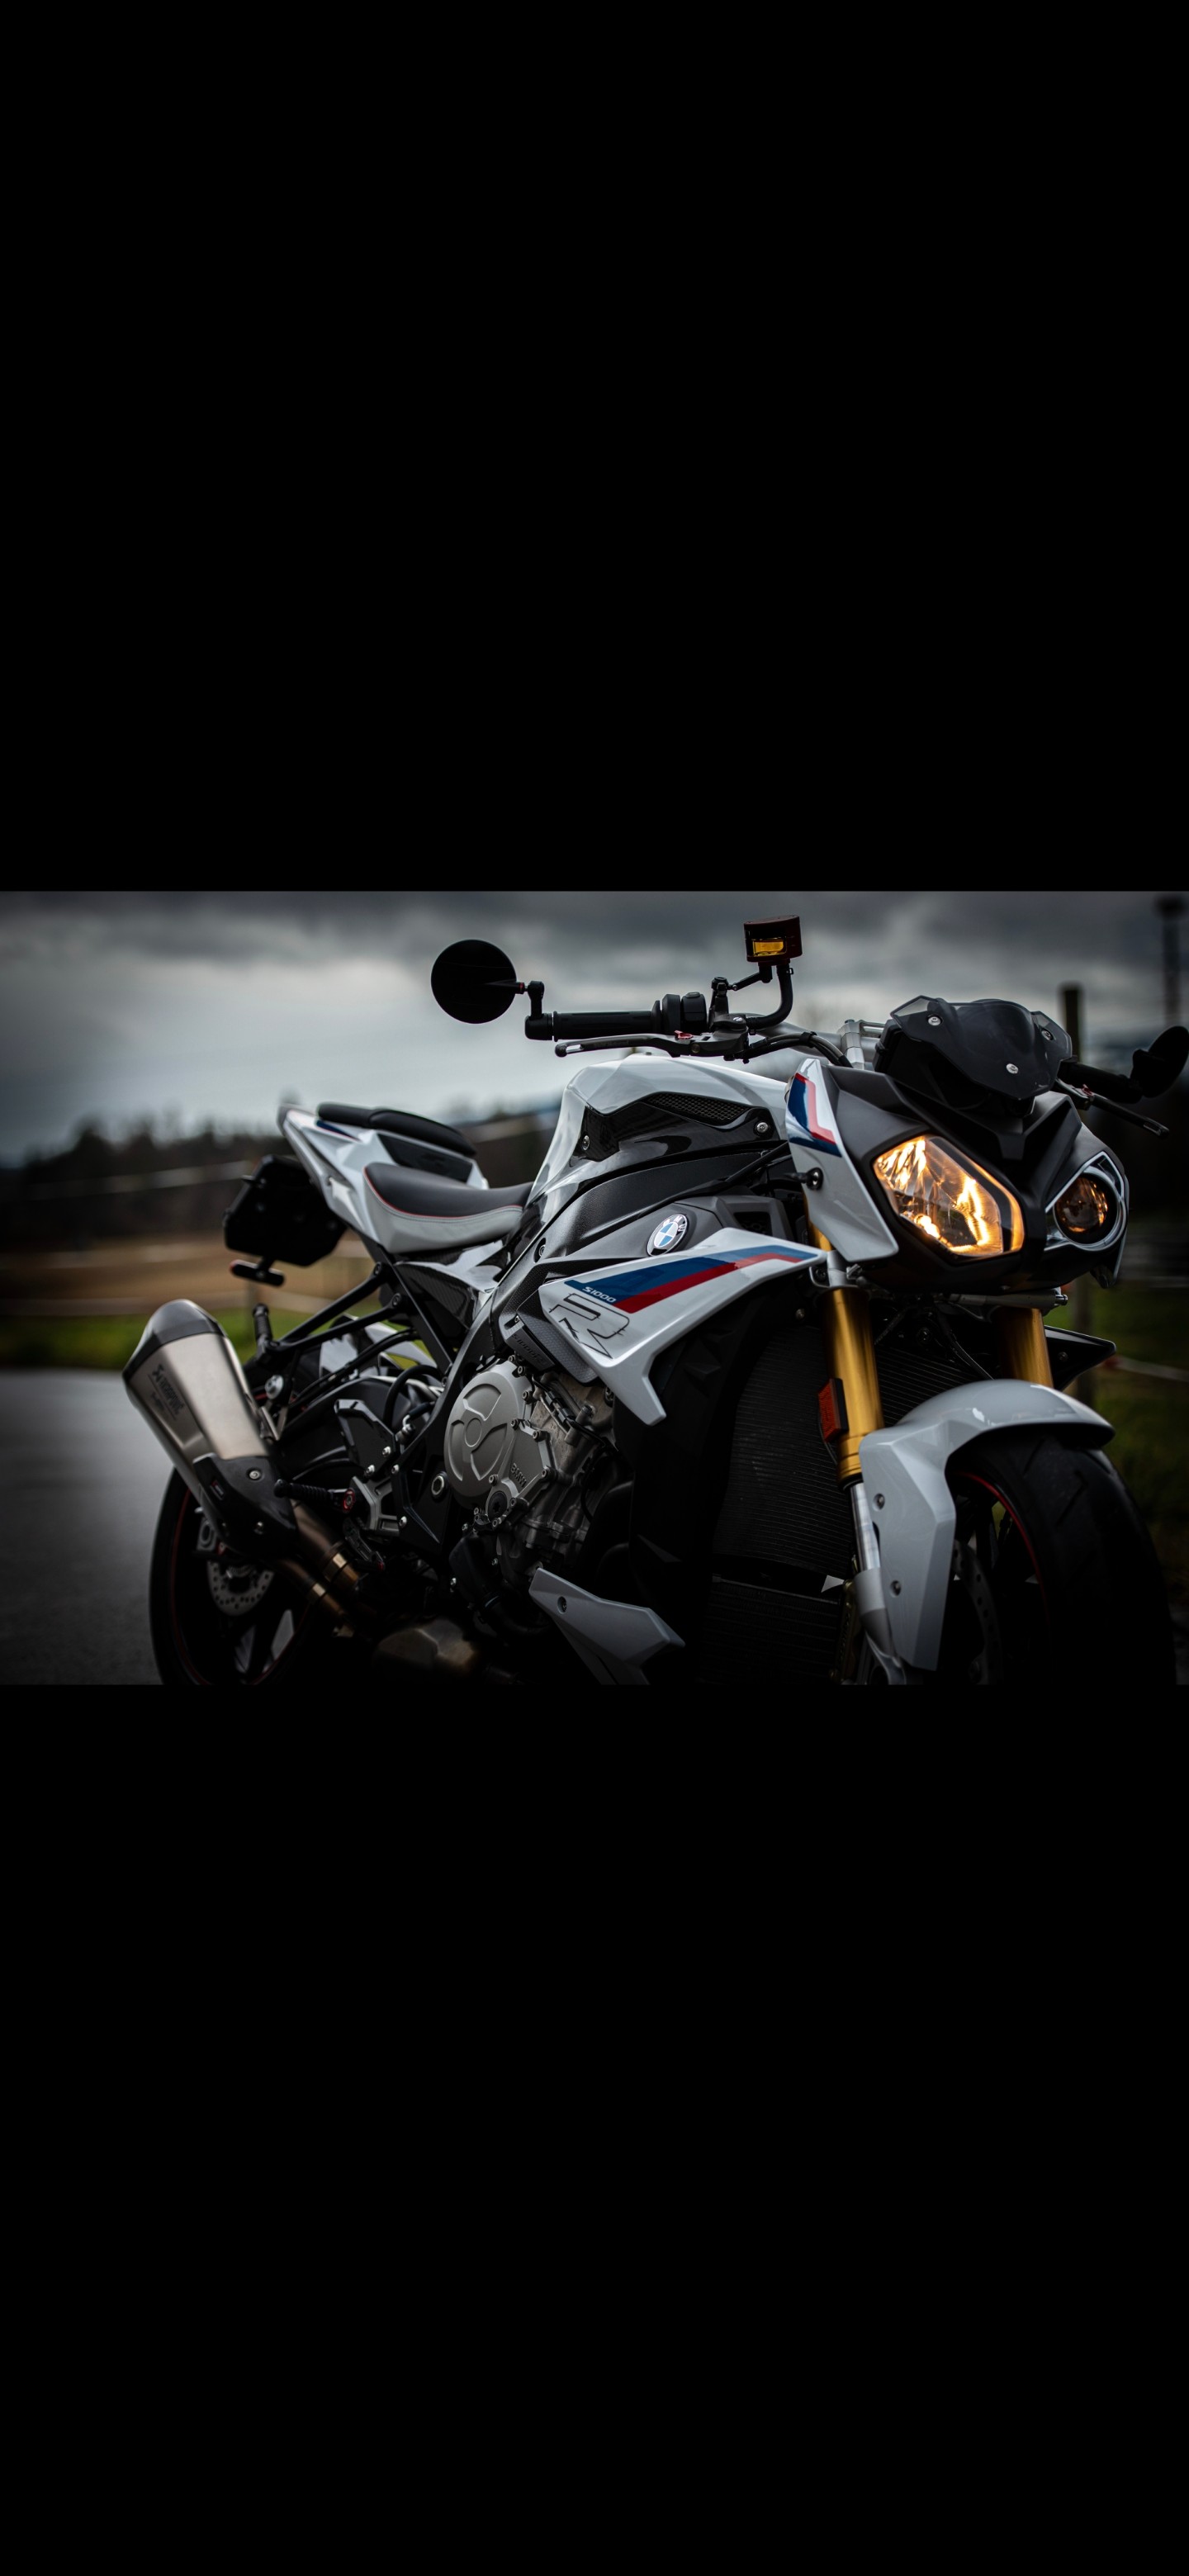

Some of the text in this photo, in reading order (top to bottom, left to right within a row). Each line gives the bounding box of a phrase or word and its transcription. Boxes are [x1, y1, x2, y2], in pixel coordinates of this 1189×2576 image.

[582, 1286, 617, 1303] S1000
[548, 1293, 629, 1359] R
[511, 1462, 527, 1488] BMW
